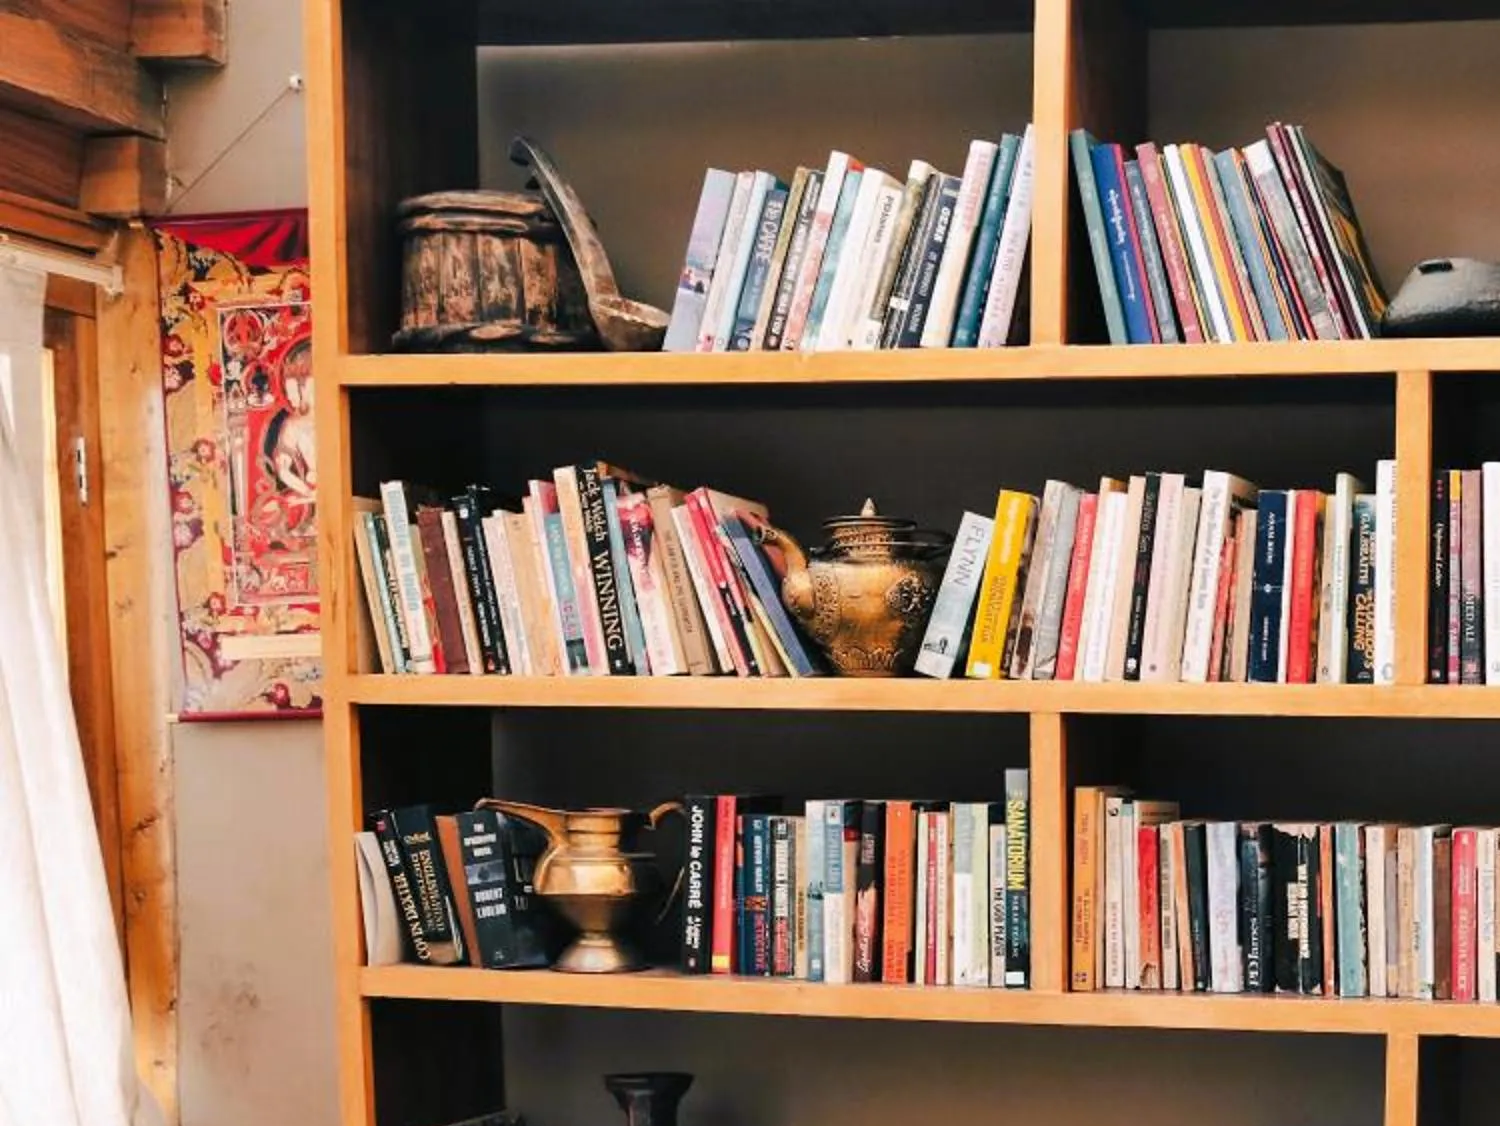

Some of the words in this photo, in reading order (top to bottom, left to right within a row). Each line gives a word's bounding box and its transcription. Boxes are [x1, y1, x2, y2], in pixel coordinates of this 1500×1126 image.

[583, 467, 600, 496] Jack
[590, 498, 608, 543] Welch
[952, 525, 985, 588] FLYNN
[1357, 512, 1371, 585] GALBRAITH
[592, 551, 623, 651] WINNING
[1354, 593, 1368, 651] CALLING
[689, 825, 705, 863] JOHN
[1006, 799, 1026, 891] SANATORIUM
[393, 872, 420, 921] DEXTER
[689, 865, 701, 879] le
[993, 887, 1004, 902] THE
[687, 880, 705, 929] CARRÉ
[754, 932, 765, 990] DETECTIVE
